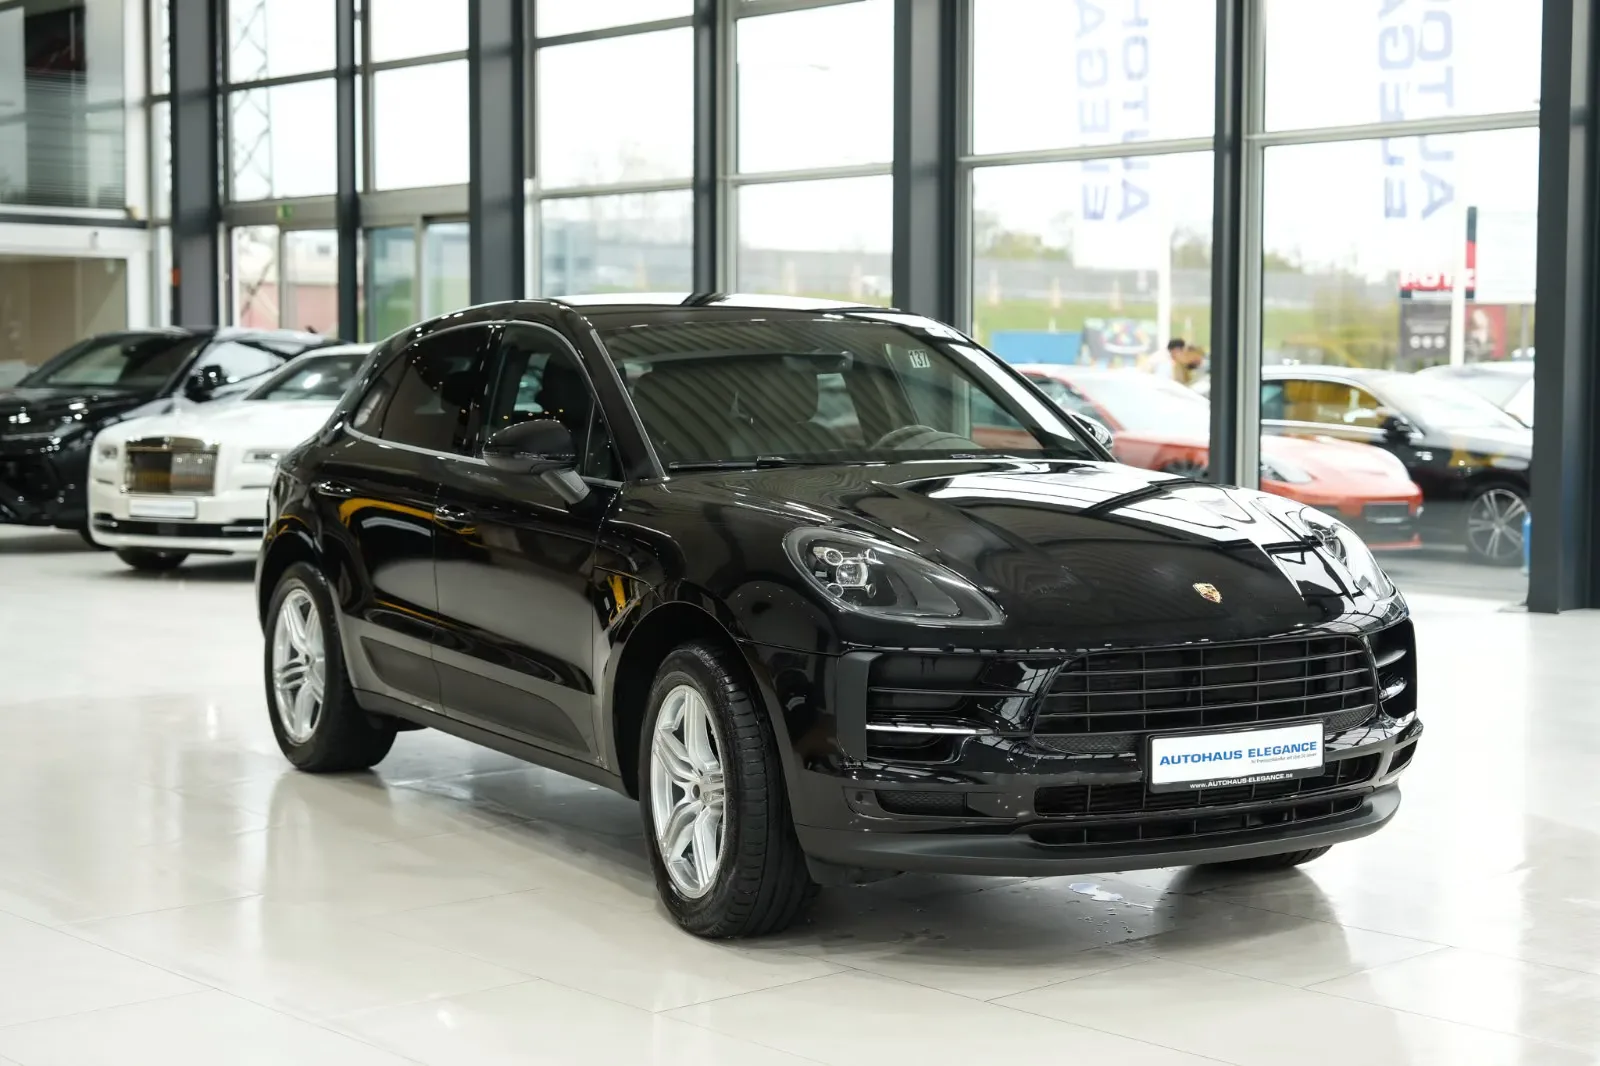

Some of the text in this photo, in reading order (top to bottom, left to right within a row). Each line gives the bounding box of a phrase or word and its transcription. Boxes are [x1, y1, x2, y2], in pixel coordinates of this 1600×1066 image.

[909, 350, 931, 368] 137
[1159, 749, 1243, 766] AUTOHAUS
[1248, 741, 1317, 758] ELEGANCE
